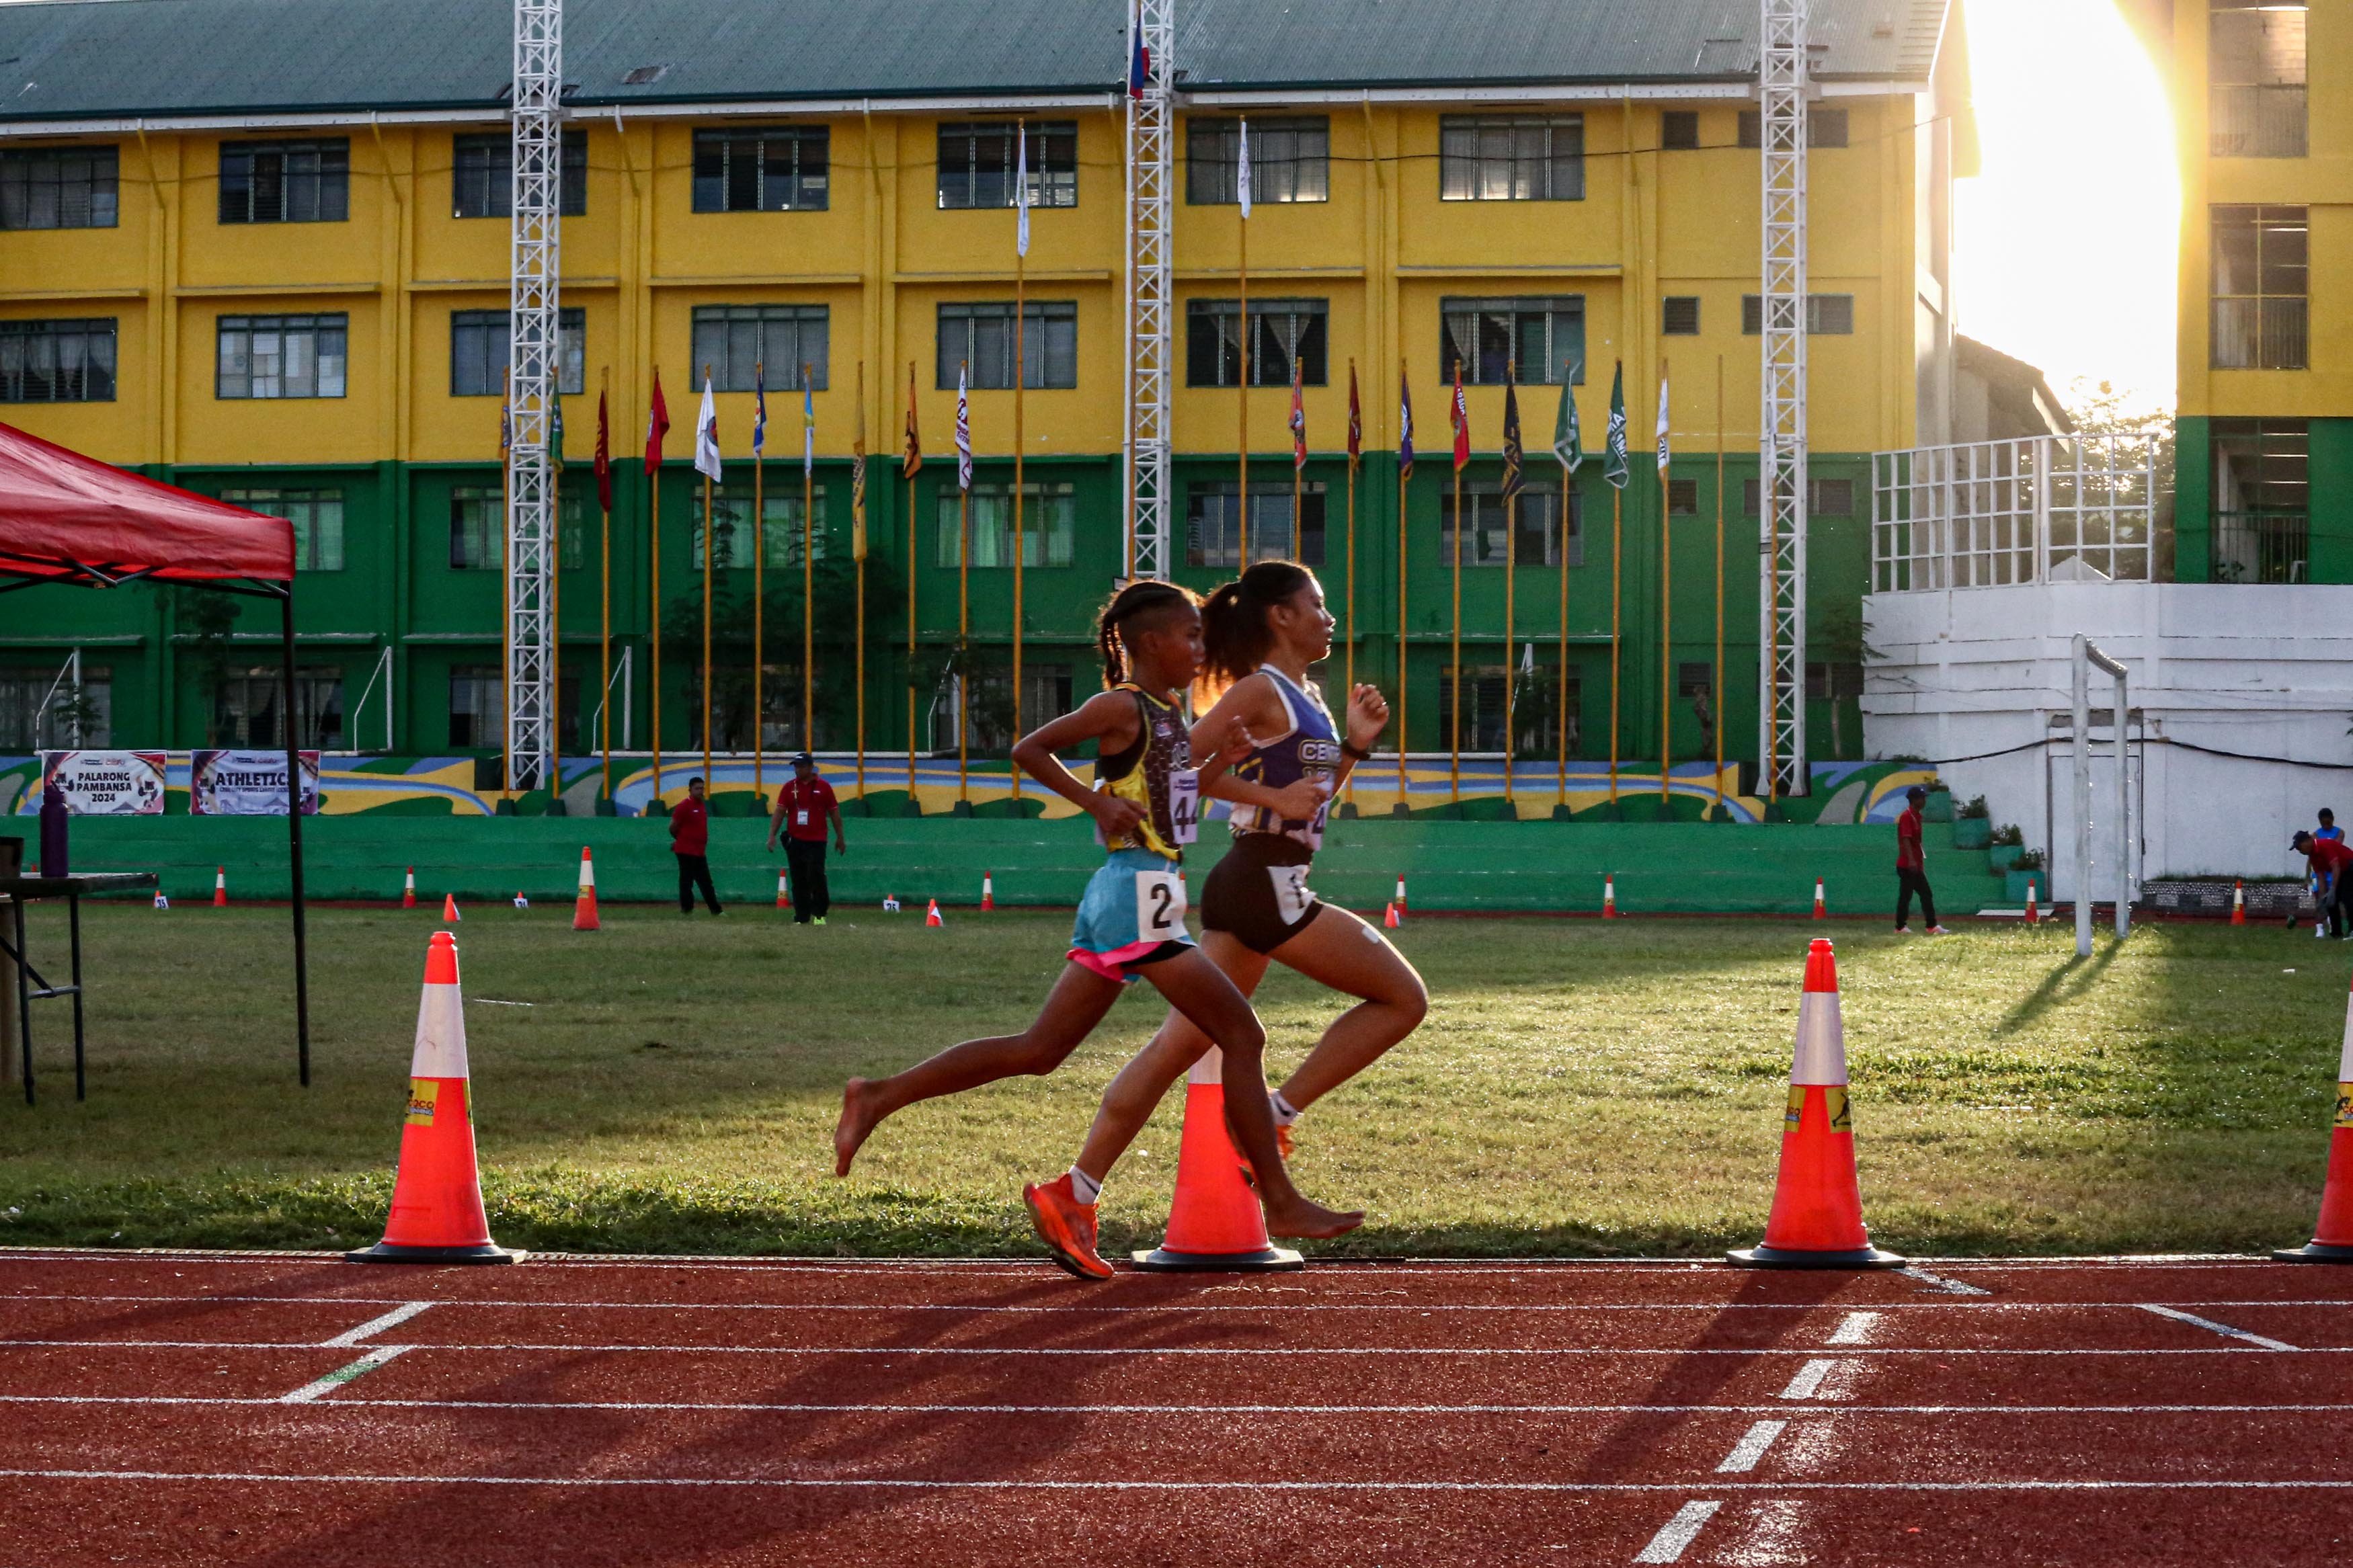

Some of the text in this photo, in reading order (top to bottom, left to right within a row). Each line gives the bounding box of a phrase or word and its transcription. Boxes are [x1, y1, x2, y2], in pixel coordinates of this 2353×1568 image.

[78, 772, 130, 781] PALARONG
[215, 772, 290, 786] ATHLETIC
[77, 782, 132, 792] PAMBANSA
[91, 794, 116, 802] 2024
[1150, 883, 1171, 930] 2
